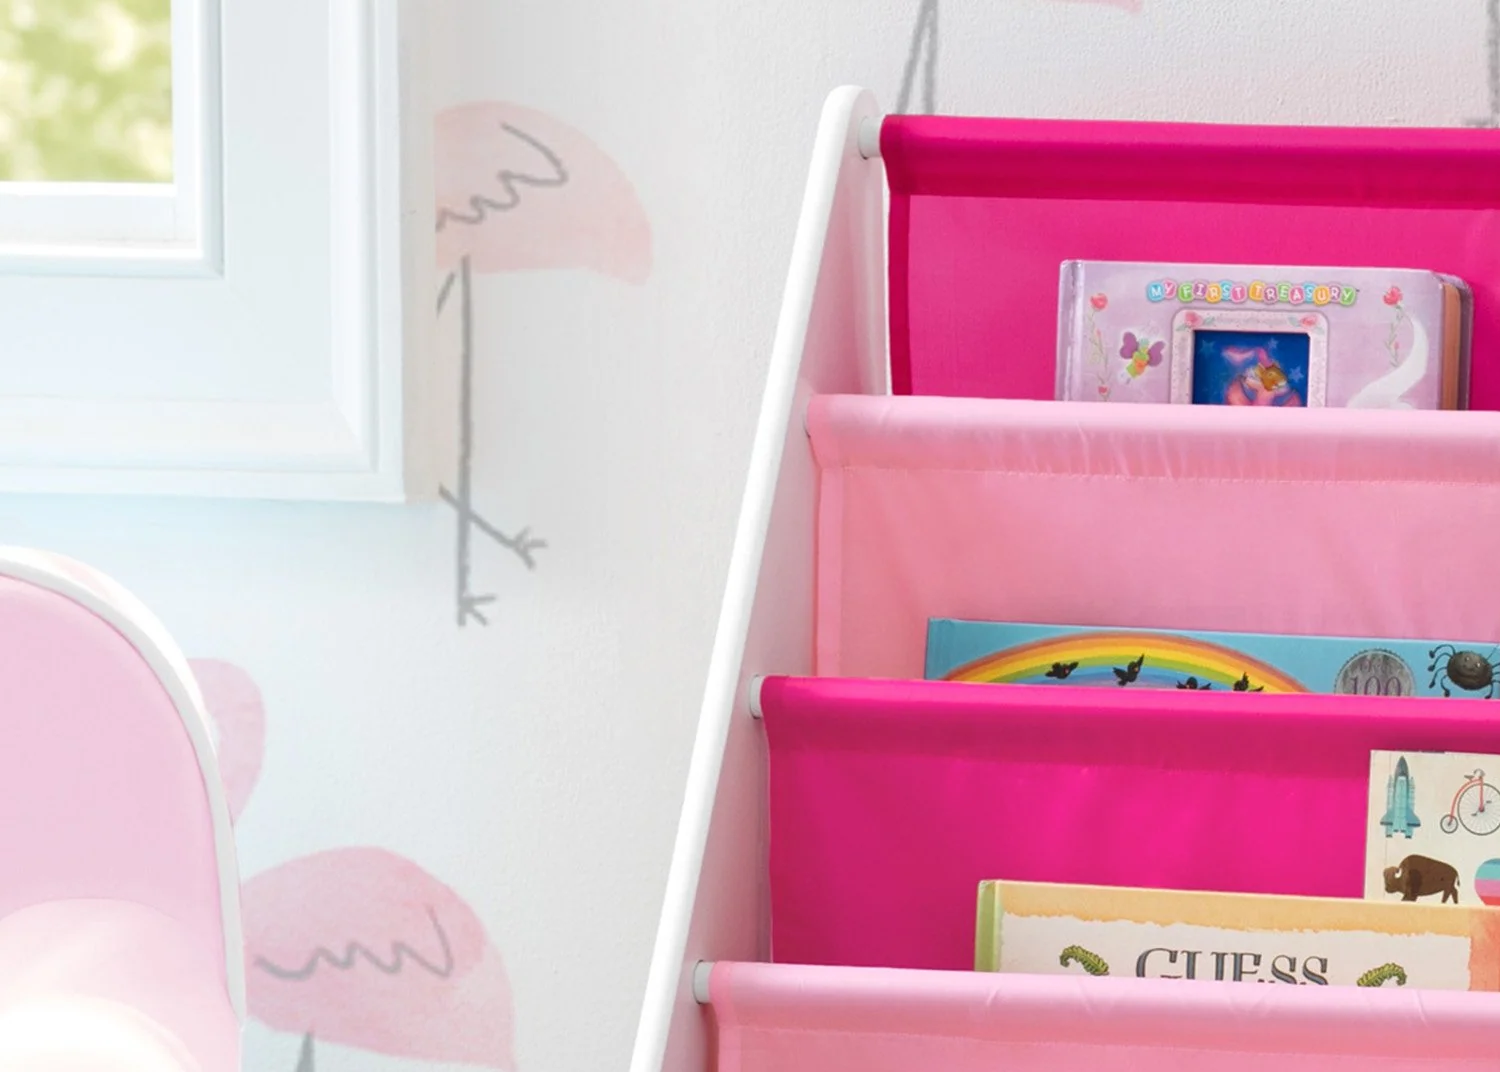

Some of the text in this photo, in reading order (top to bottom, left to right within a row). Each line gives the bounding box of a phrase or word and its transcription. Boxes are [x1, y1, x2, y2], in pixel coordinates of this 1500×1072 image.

[1149, 281, 1355, 303] MY FIRST TREASURY
[1349, 675, 1402, 696] 100
